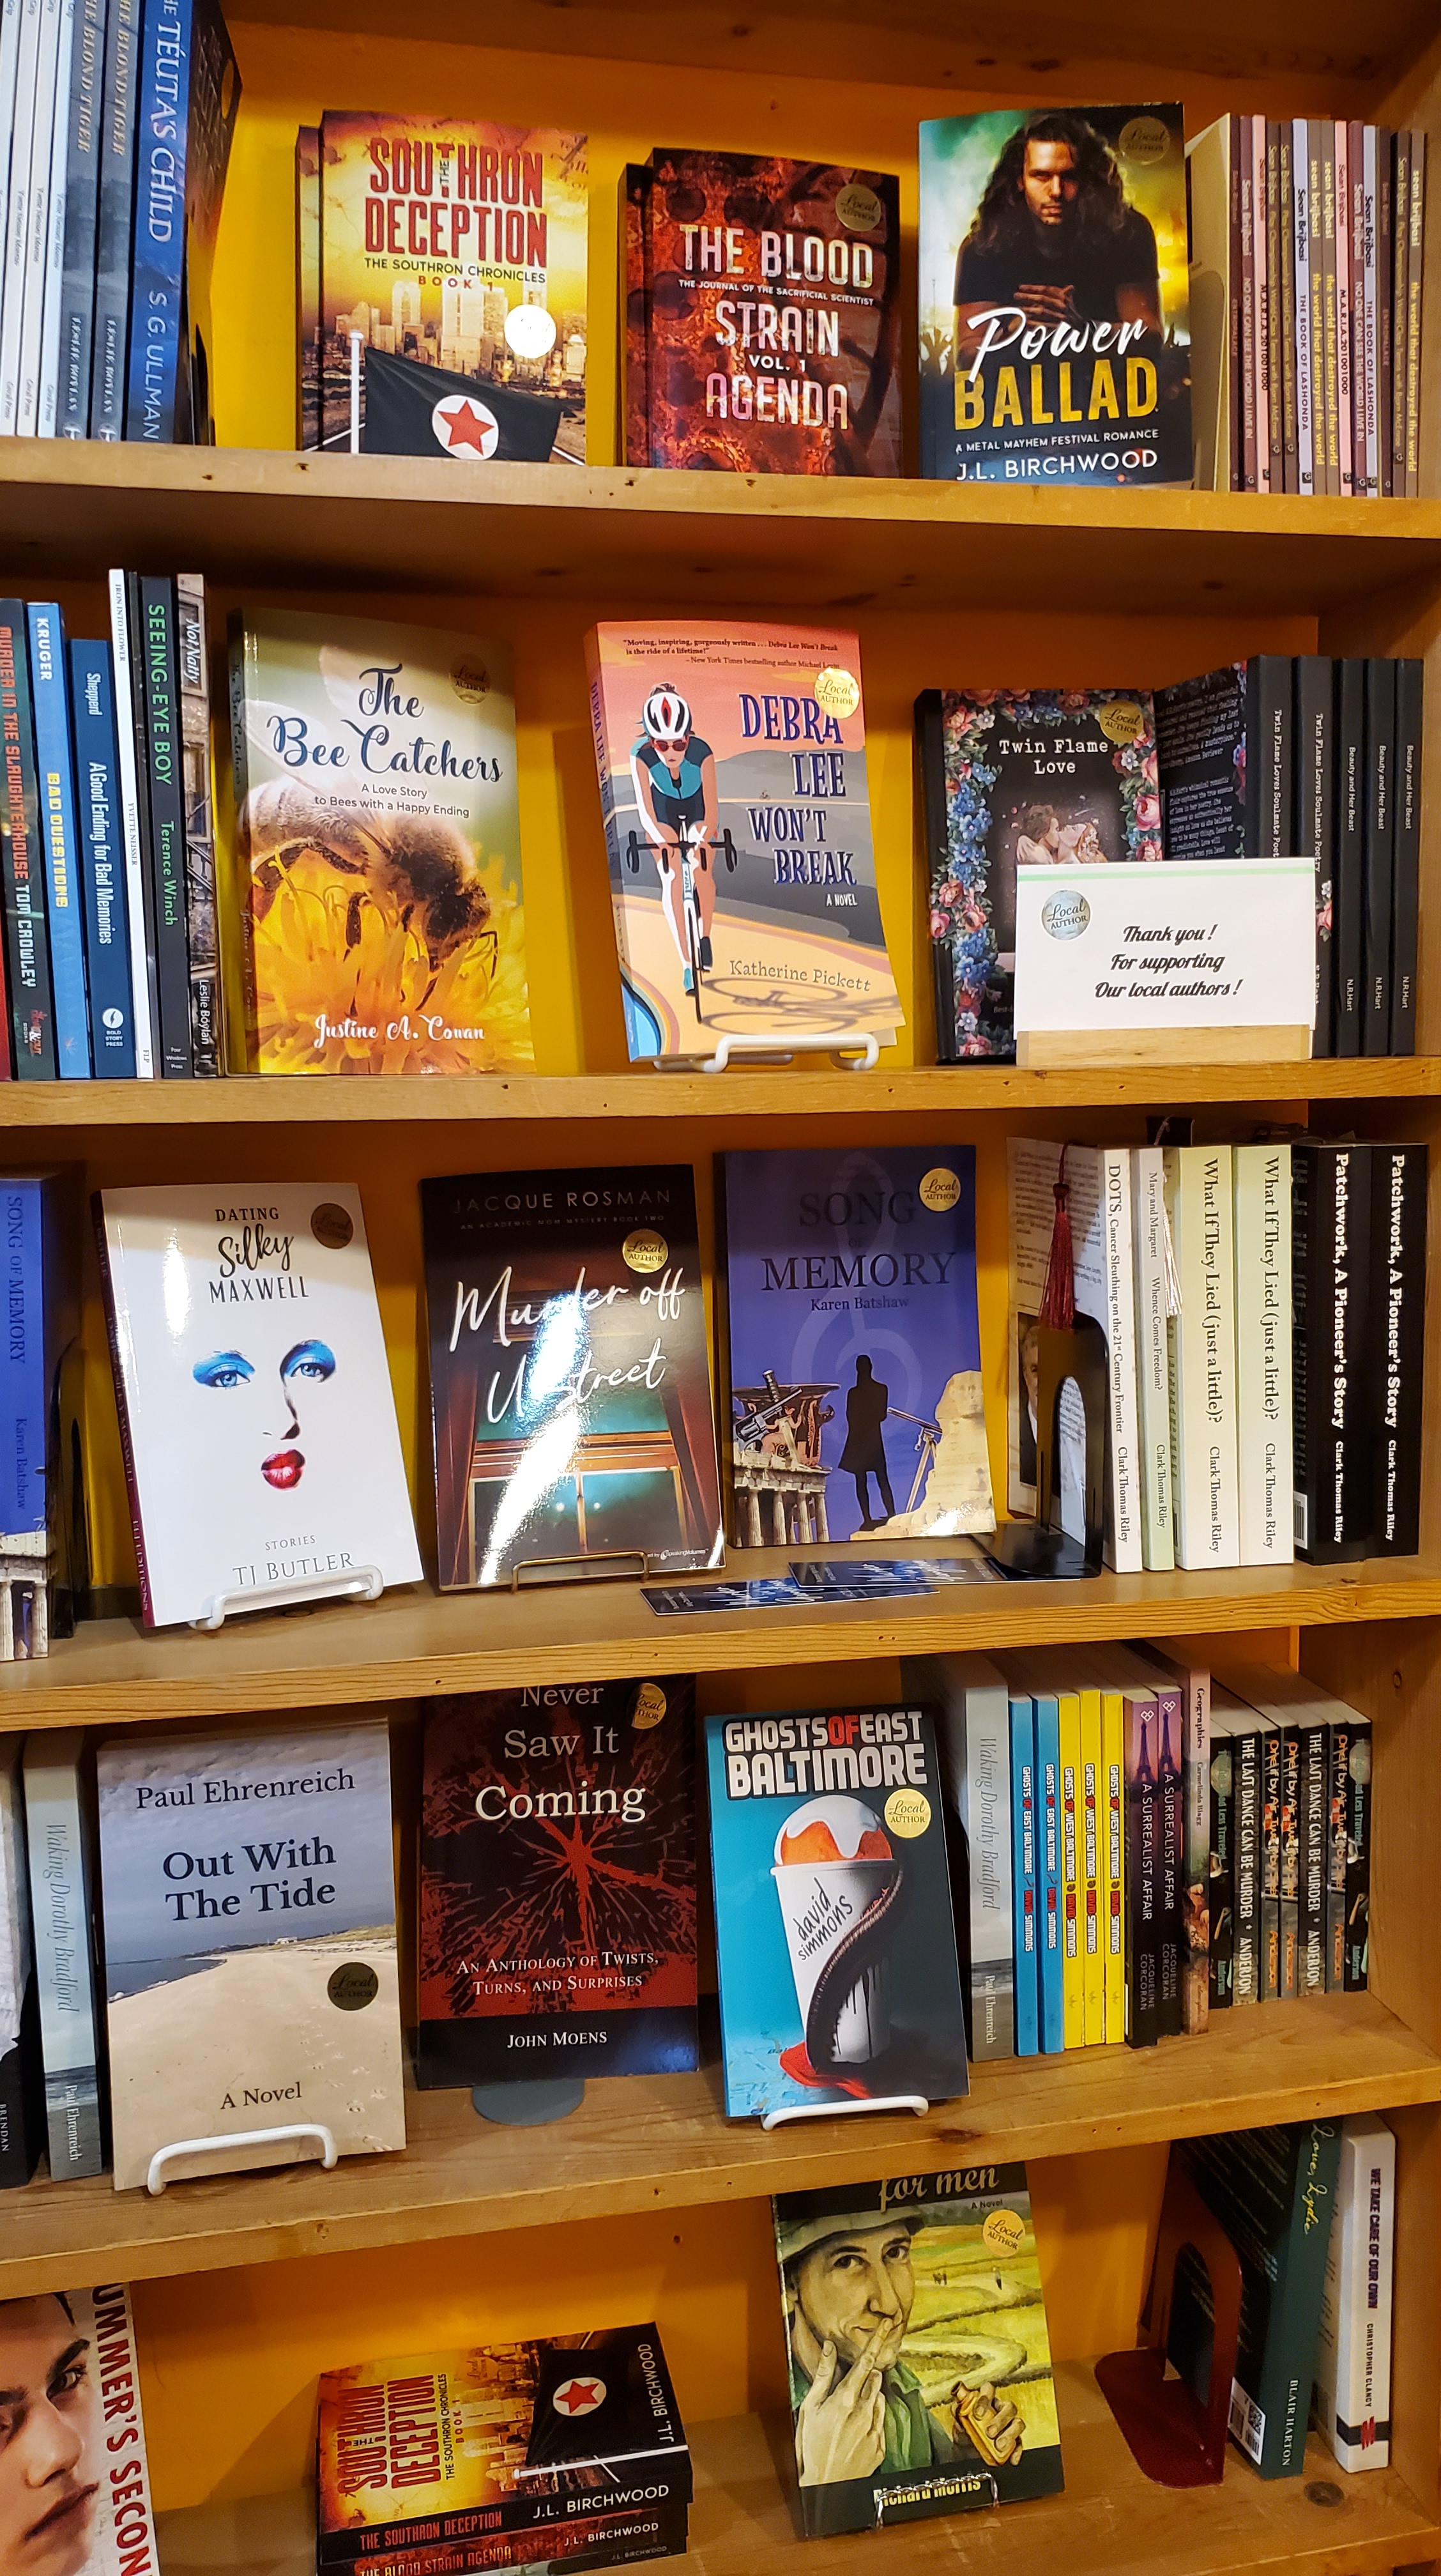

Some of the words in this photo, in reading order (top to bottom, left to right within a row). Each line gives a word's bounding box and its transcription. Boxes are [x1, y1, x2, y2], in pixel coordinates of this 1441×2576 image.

[148, 147, 176, 243] CHILD
[365, 197, 547, 268] DECEPTION
[364, 257, 387, 270] THE
[392, 259, 463, 275] SOUTHRON
[468, 264, 545, 283] CHRONICLES
[679, 224, 743, 275] THE
[761, 231, 874, 289] BLOOD
[149, 291, 167, 310] S.
[679, 279, 696, 289] THE
[698, 281, 739, 291] JOURNAL
[742, 284, 754, 293] OF
[758, 285, 774, 294] THE
[777, 288, 828, 301] SACRIFICIAL
[831, 293, 874, 306] SCIENTIST
[147, 315, 166, 339] G.
[715, 300, 839, 356] STRAIN
[967, 307, 1148, 383] Power
[1300, 353, 1307, 368] OF
[143, 341, 164, 439] ULLMAN
[706, 373, 848, 430] AGENDA
[954, 356, 1159, 431] BALLAD
[956, 443, 963, 454] A
[966, 441, 1000, 452] METAL
[1004, 437, 1048, 449] MAYHEM
[1051, 433, 1100, 447] FESTIVAL
[1104, 429, 1159, 443] ROMANCE
[957, 462, 995, 480] J.L.
[1005, 449, 1157, 479] BIRCHWOOD
[37, 617, 52, 681] KRUGER
[148, 604, 170, 734] SEEING-EYE
[84, 672, 103, 716] Sheppard
[358, 663, 424, 718] The
[739, 694, 844, 744] DEBRA
[154, 741, 172, 785] BOY
[266, 716, 351, 767] Bee
[340, 719, 503, 783] Catchers
[999, 739, 1047, 755] Twin
[1054, 739, 1109, 753] Flame
[1348, 746, 1356, 775] Beauty
[89, 762, 107, 772] A
[791, 751, 846, 798] LEE
[1034, 760, 1076, 774] Love
[89, 773, 109, 802] Good
[361, 784, 370, 794] A
[372, 785, 397, 797] Love
[400, 786, 427, 801] Story
[89, 804, 110, 842] Ending
[315, 795, 326, 806] to
[330, 796, 356, 809] Bees
[360, 798, 385, 811] with
[397, 801, 431, 816] Happy
[434, 804, 469, 818] Ending
[93, 845, 111, 862] for
[160, 820, 174, 875] Terence
[95, 863, 112, 886] Bad
[773, 848, 857, 886] BREAK
[96, 888, 115, 944] Memories
[162, 877, 178, 926] Winch
[827, 894, 832, 907] A
[835, 893, 858, 907] NOVEL
[1047, 900, 1087, 922] Local
[1050, 915, 1088, 930] AUTHOR
[1123, 926, 1172, 943] Thank
[1174, 928, 1205, 946] you
[729, 960, 809, 983] Katherine
[812, 968, 872, 992] Pickett
[1110, 954, 1136, 970] For
[1139, 953, 1225, 974] supporting
[1095, 982, 1126, 999] Our
[1129, 981, 1168, 997] local
[1170, 980, 1230, 997] authors
[314, 1014, 379, 1048] Justine
[386, 1016, 419, 1040] A.
[419, 1015, 485, 1041] Cowan
[453, 1192, 554, 1215] JACQUE
[567, 1190, 670, 1208] ROSMAN
[1108, 1164, 1122, 1216] DOTS,
[215, 1208, 280, 1222] DATING
[1332, 1153, 1349, 1264] Patchwork,
[218, 1223, 294, 1278] Silky
[1110, 1219, 1119, 1254] Cancer
[760, 1252, 956, 1292] MEMORY
[1109, 1255, 1120, 1301] Sleuthing
[1334, 1268, 1348, 1284] A
[209, 1276, 309, 1304] MAXWELL
[811, 1296, 850, 1312] Karen
[854, 1294, 910, 1310] Batshaw
[1113, 1303, 1118, 1316] on
[1113, 1318, 1122, 1333] the
[1112, 1353, 1123, 1393] Century
[1115, 1394, 1124, 1434] Frontier
[1330, 1381, 1347, 1430] Story
[265, 1535, 316, 1551] STORIES
[233, 1565, 258, 1586] TJ
[266, 1552, 355, 1581] BUTLER
[726, 1717, 829, 1752] GHOSTS
[859, 1711, 922, 1744] EAST
[1195, 1687, 1205, 1749] Geographies
[504, 1729, 581, 1759] Saw
[592, 1726, 619, 1755] It
[1242, 1738, 1255, 1759] THE
[728, 1744, 927, 1797] BALTIMORE
[1164, 1774, 1174, 1783] A
[1241, 1762, 1254, 1786] LAST
[135, 1783, 195, 1809] Paul
[203, 1768, 356, 1803] Ehrenreich
[475, 1781, 646, 1823] Coming
[1241, 1790, 1254, 1827] DANCE
[1164, 1786, 1174, 1866] SURREALIST
[1240, 1828, 1254, 1851] CAN
[162, 1851, 234, 1880] Out
[241, 1836, 338, 1873] With
[1240, 1852, 1254, 1869] BE
[165, 1886, 242, 1920] The
[250, 1877, 337, 1913] Tide
[1164, 1869, 1174, 1910] AFFAIR
[1239, 1870, 1254, 1919] MURDER
[1238, 1936, 1251, 1995] ANDERSON
[220, 2092, 237, 2110] A
[243, 2081, 303, 2106] Novel
[878, 2175, 927, 2213] for
[936, 2166, 1000, 2195] men
[1371, 2168, 1381, 2186] WE
[979, 2198, 1003, 2209] Novel
[1370, 2186, 1380, 2212] TAKE
[1369, 2214, 1380, 2242] CARE
[1369, 2243, 1379, 2258] OF
[1368, 2259, 1378, 2281] OUR
[1368, 2282, 1378, 2308] OWN
[1288, 2379, 1299, 2414] BLAIR
[1282, 2418, 1295, 2466] HARTON
[533, 2506, 560, 2520] J.L.
[567, 2484, 669, 2513] BIRCHWOOD
